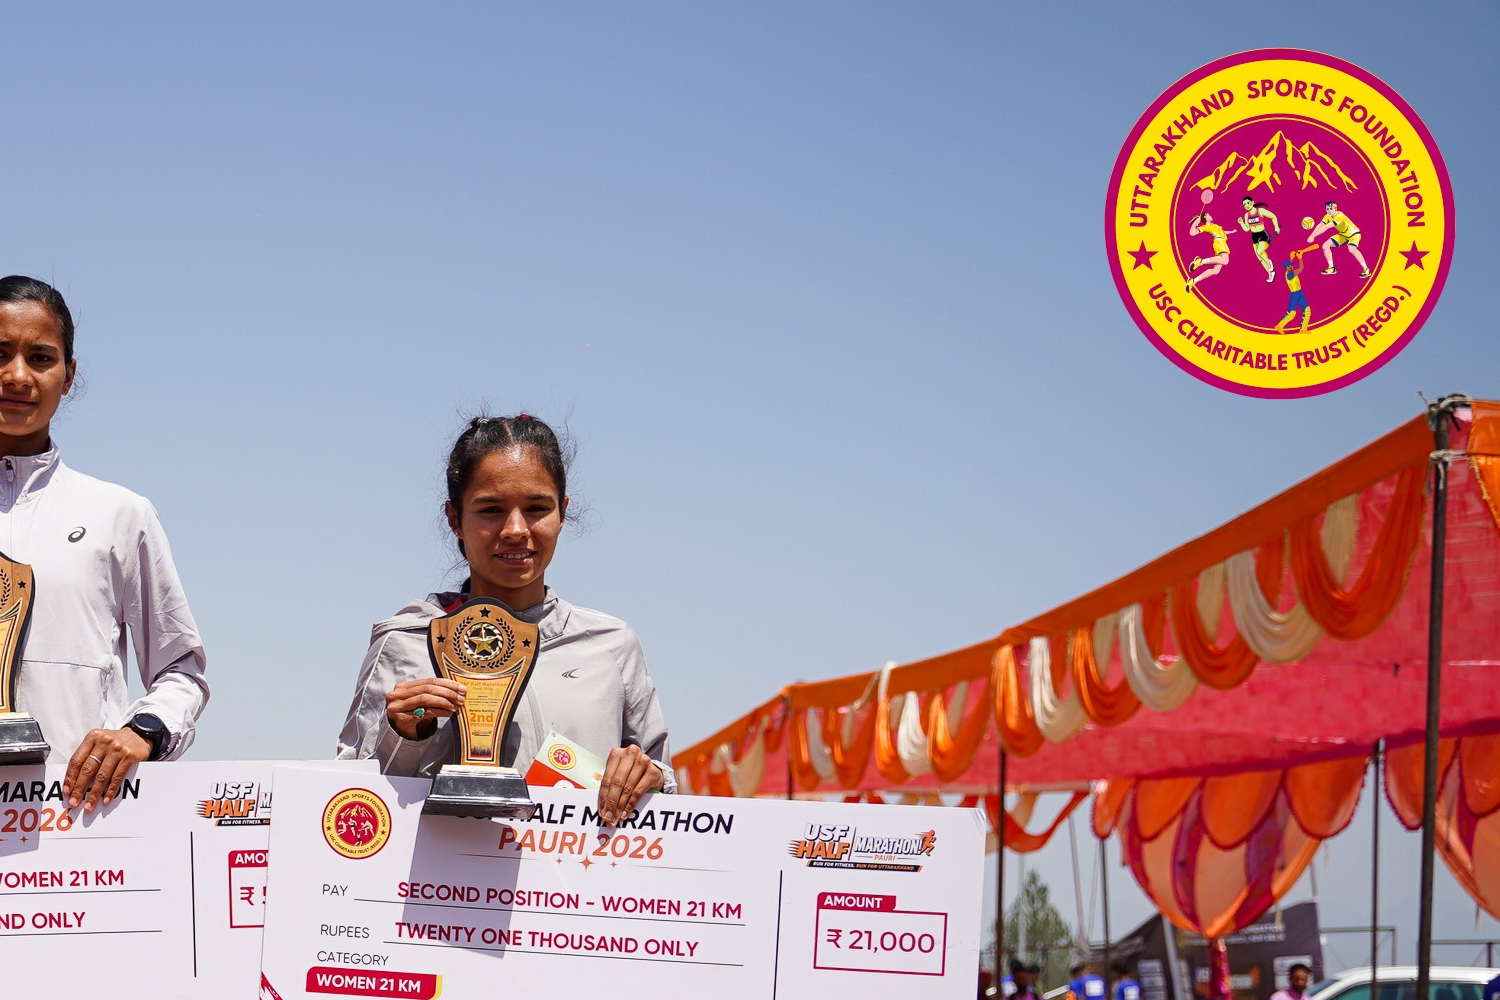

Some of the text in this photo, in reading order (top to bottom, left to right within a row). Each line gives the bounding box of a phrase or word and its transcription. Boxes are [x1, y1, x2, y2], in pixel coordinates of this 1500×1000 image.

[470, 713, 493, 722] 2nd
[210, 782, 254, 799] USF
[204, 799, 255, 818] HALF
[1, 808, 73, 833] 2026
[509, 803, 734, 834] ALF MRATHON
[804, 823, 850, 842] USF
[498, 827, 664, 860] PAURI 2026
[797, 841, 850, 860] HALF
[69, 871, 88, 886] 21
[95, 870, 124, 886] KM
[322, 881, 742, 919] PAY SECOND POSITION WOMEN 21 KM
[823, 896, 883, 909] AMOUNT
[31, 912, 86, 929] ONLY
[320, 921, 699, 957] RUPEES TWENTY ONE THOUSAND ONLY
[848, 930, 935, 953] 21,000
[317, 951, 389, 966] CATEGORY
[316, 974, 421, 993] WOMEN 21 KM
